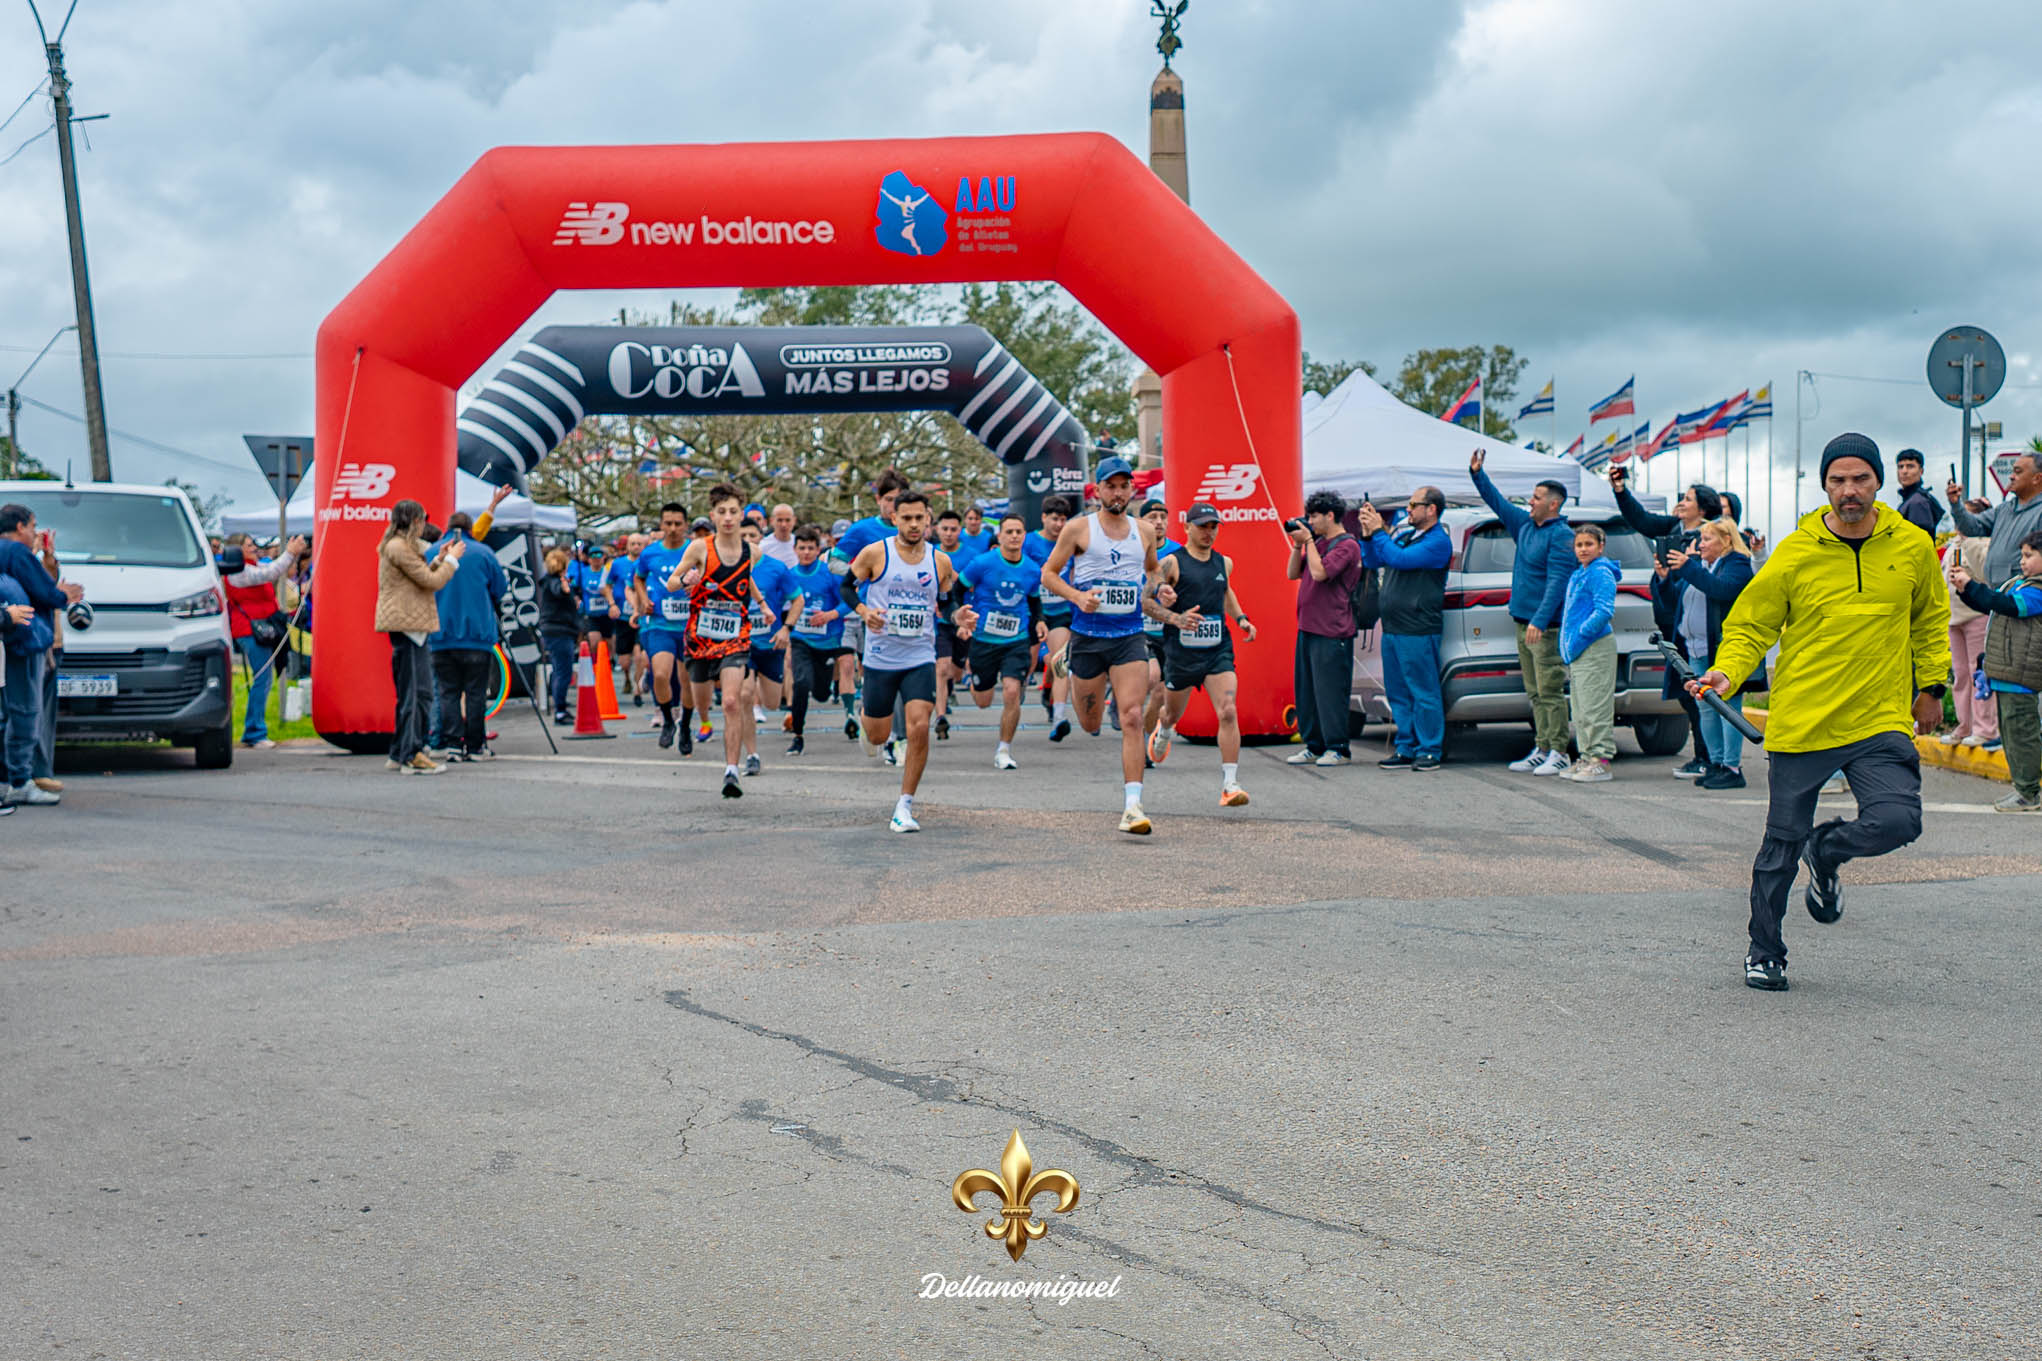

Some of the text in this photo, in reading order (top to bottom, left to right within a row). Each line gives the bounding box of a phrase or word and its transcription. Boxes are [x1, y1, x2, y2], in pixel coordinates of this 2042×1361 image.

[955, 175, 1015, 212] AAU
[631, 222, 695, 246] new
[701, 215, 834, 244] balance
[651, 344, 728, 367] Doña
[790, 347, 943, 363] JUNTOS LLEGAMOS
[785, 367, 949, 394] MÁS LEJOS
[343, 504, 392, 521] balan
[1218, 506, 1278, 522] alance
[1106, 590, 1135, 605] 16538
[711, 618, 736, 633] 15748
[899, 614, 924, 629] 15694
[1194, 622, 1220, 638] 16589
